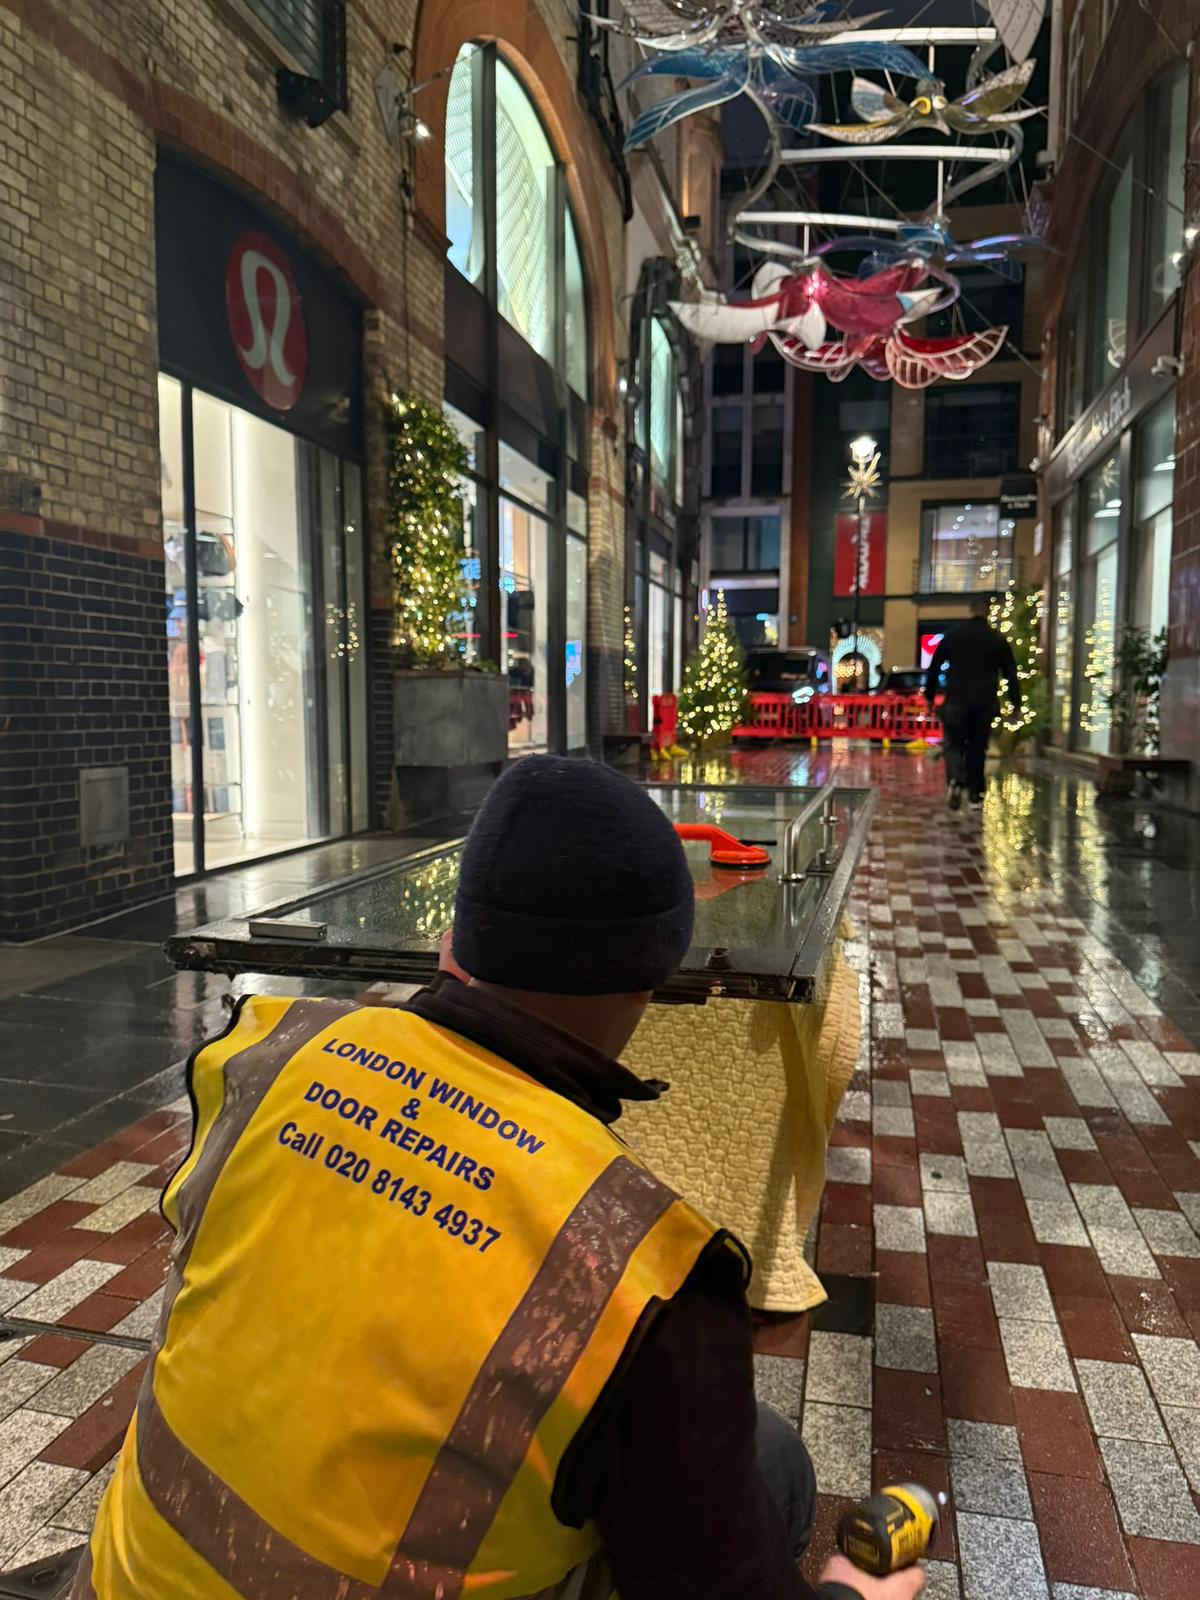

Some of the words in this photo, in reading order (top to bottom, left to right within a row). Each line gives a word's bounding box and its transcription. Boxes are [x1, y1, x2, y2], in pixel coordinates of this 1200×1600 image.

[304, 1081, 378, 1131] DOOR
[380, 1119, 495, 1191] REPAIRS
[322, 1038, 427, 1091] LONDON
[429, 1078, 546, 1155] WINDOW
[400, 1098, 421, 1121] &
[278, 1121, 324, 1159] Call
[324, 1144, 371, 1184] 020
[371, 1169, 432, 1217] 8143
[433, 1204, 502, 1253] 4937
